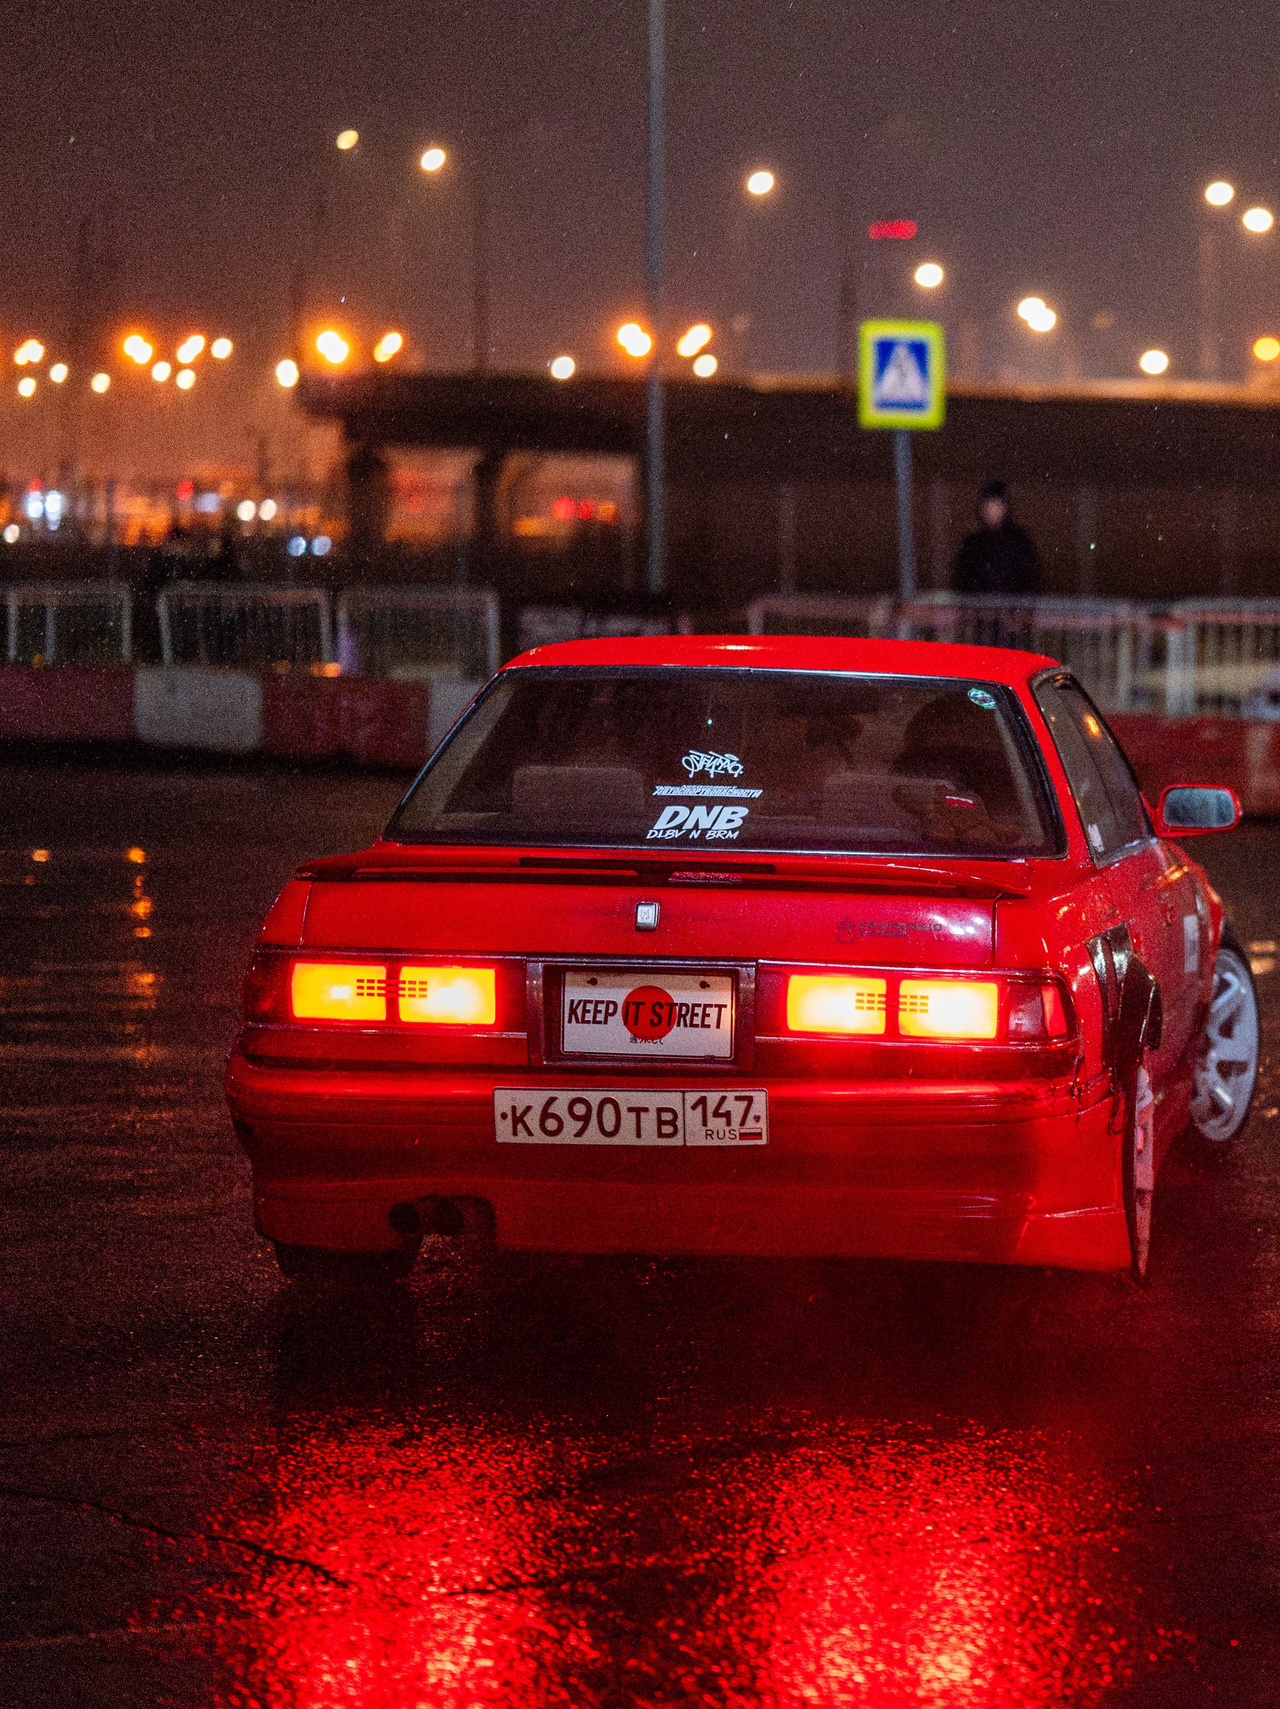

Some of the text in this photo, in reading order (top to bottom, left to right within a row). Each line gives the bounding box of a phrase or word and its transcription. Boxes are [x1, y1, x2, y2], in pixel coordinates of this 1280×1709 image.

[653, 805, 749, 830] DNB
[646, 829, 740, 840] DLBV N BRM
[567, 998, 728, 1030] KEEP IT STREET
[690, 1095, 754, 1127] 147
[705, 1128, 738, 1140] RUS
